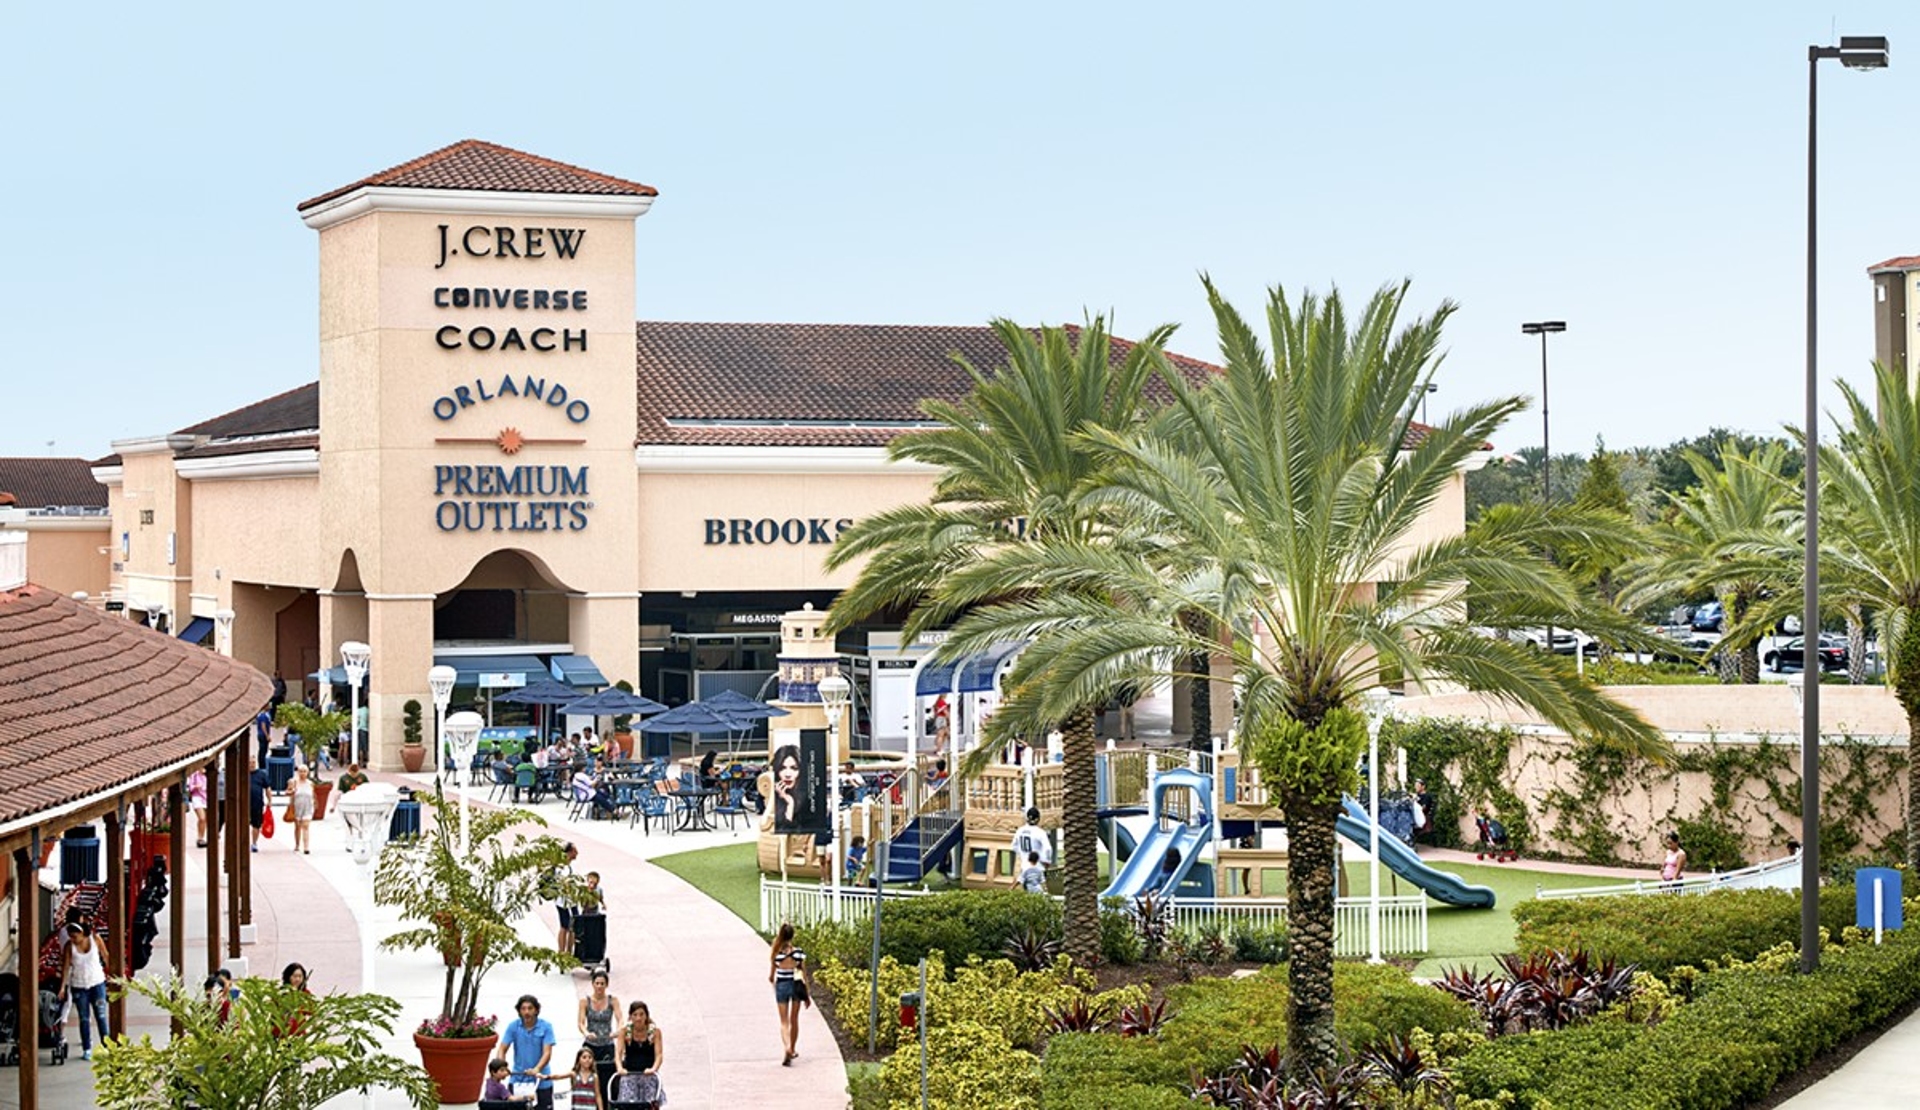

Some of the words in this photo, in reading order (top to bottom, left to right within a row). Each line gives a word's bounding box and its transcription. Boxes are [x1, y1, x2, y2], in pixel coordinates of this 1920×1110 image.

[435, 225, 587, 269] J.CREW
[434, 287, 588, 311] CONVERSE
[435, 325, 588, 351] COACH
[433, 374, 590, 423] ORLANDO
[434, 465, 589, 496] PREMIUM
